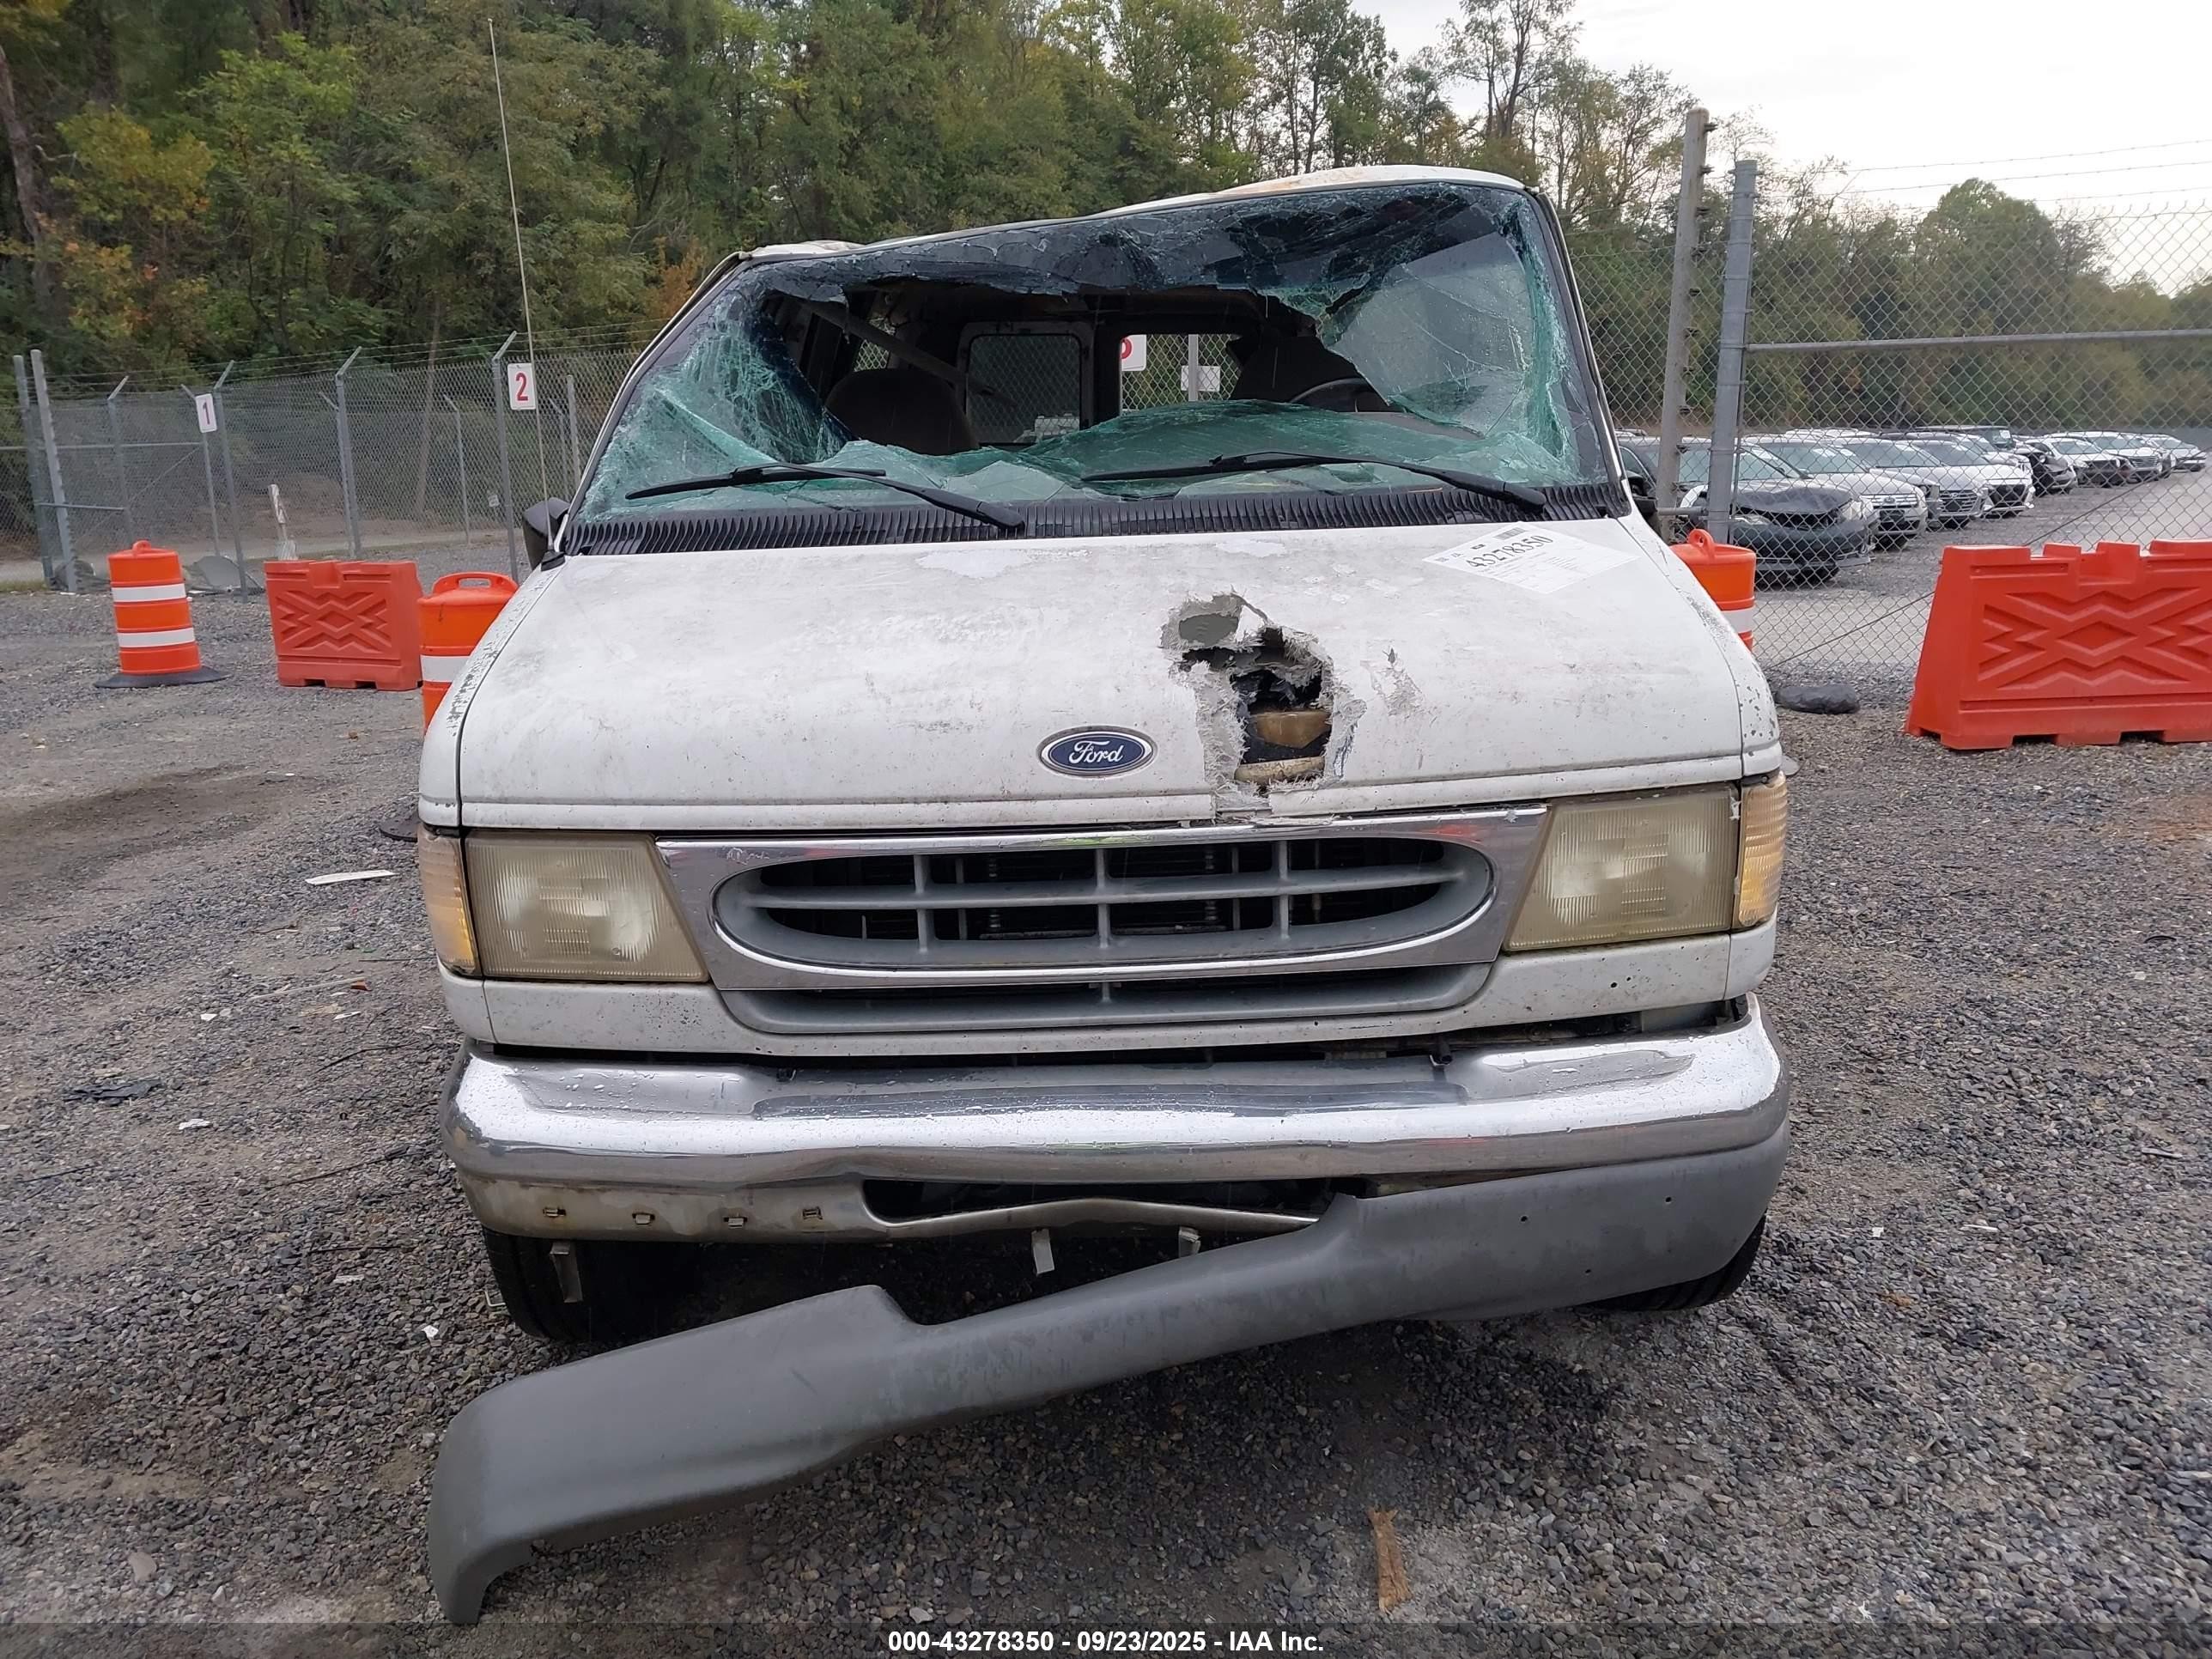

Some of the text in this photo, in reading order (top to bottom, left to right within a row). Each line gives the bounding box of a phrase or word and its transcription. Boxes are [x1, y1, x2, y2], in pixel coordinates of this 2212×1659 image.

[515, 372, 529, 401] 2
[202, 402, 210, 425] 1
[1466, 535, 1553, 568] 43278350
[1068, 740, 1124, 763] Ford
